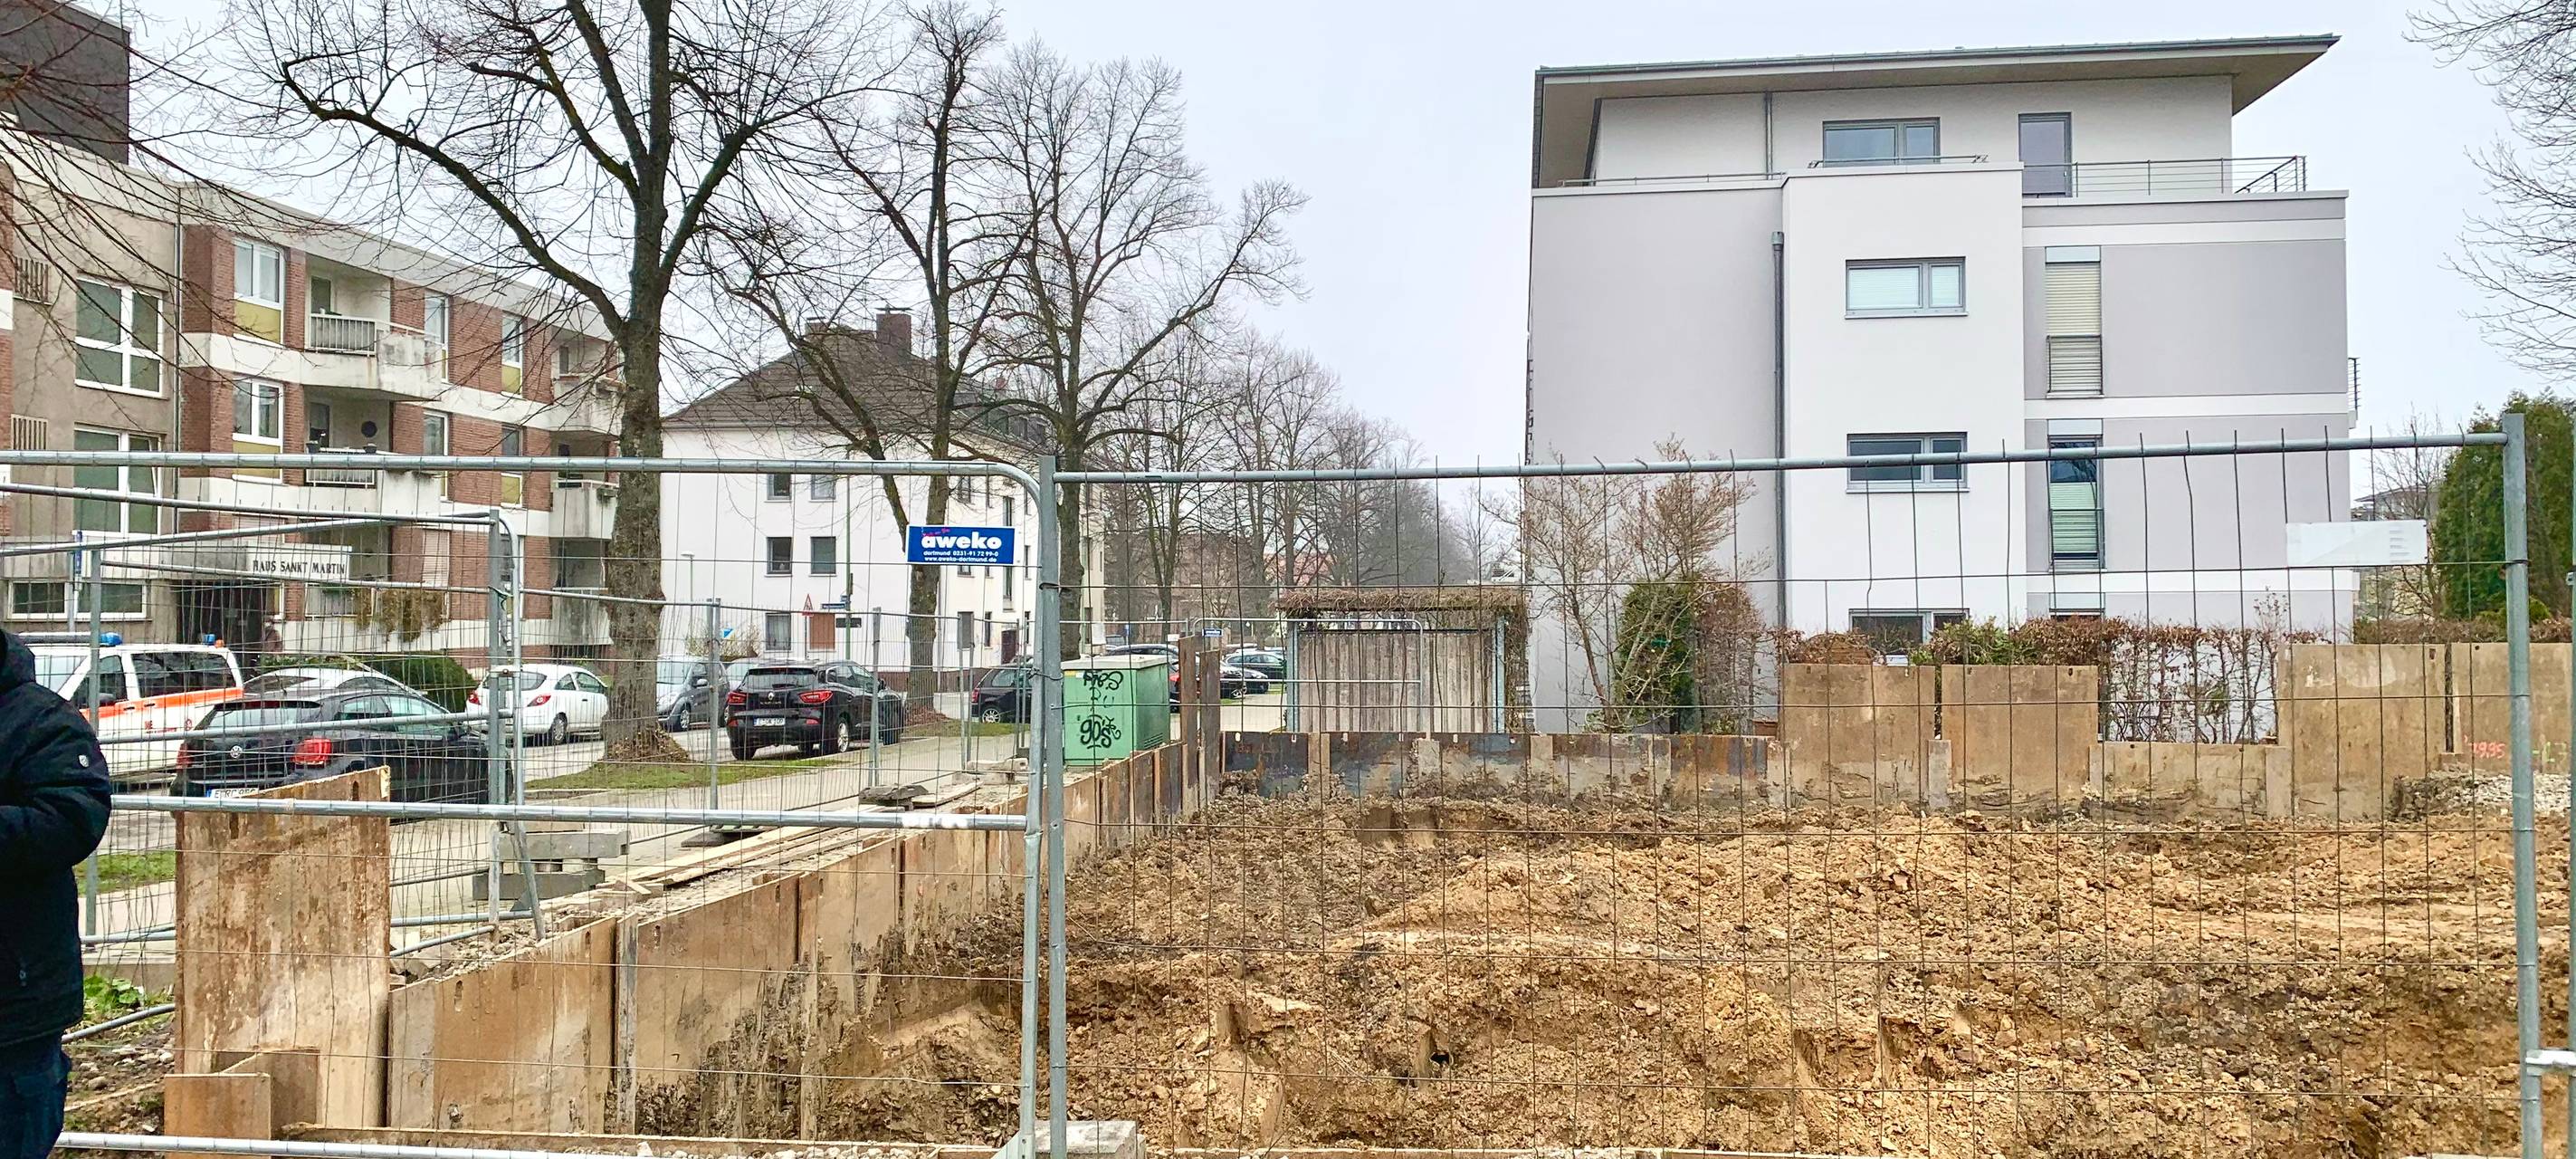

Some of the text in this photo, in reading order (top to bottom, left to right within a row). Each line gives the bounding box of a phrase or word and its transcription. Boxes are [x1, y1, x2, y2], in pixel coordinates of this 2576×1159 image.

[921, 532, 1002, 549] aweko
[253, 560, 345, 574] HAUS SANKT MARTIN
